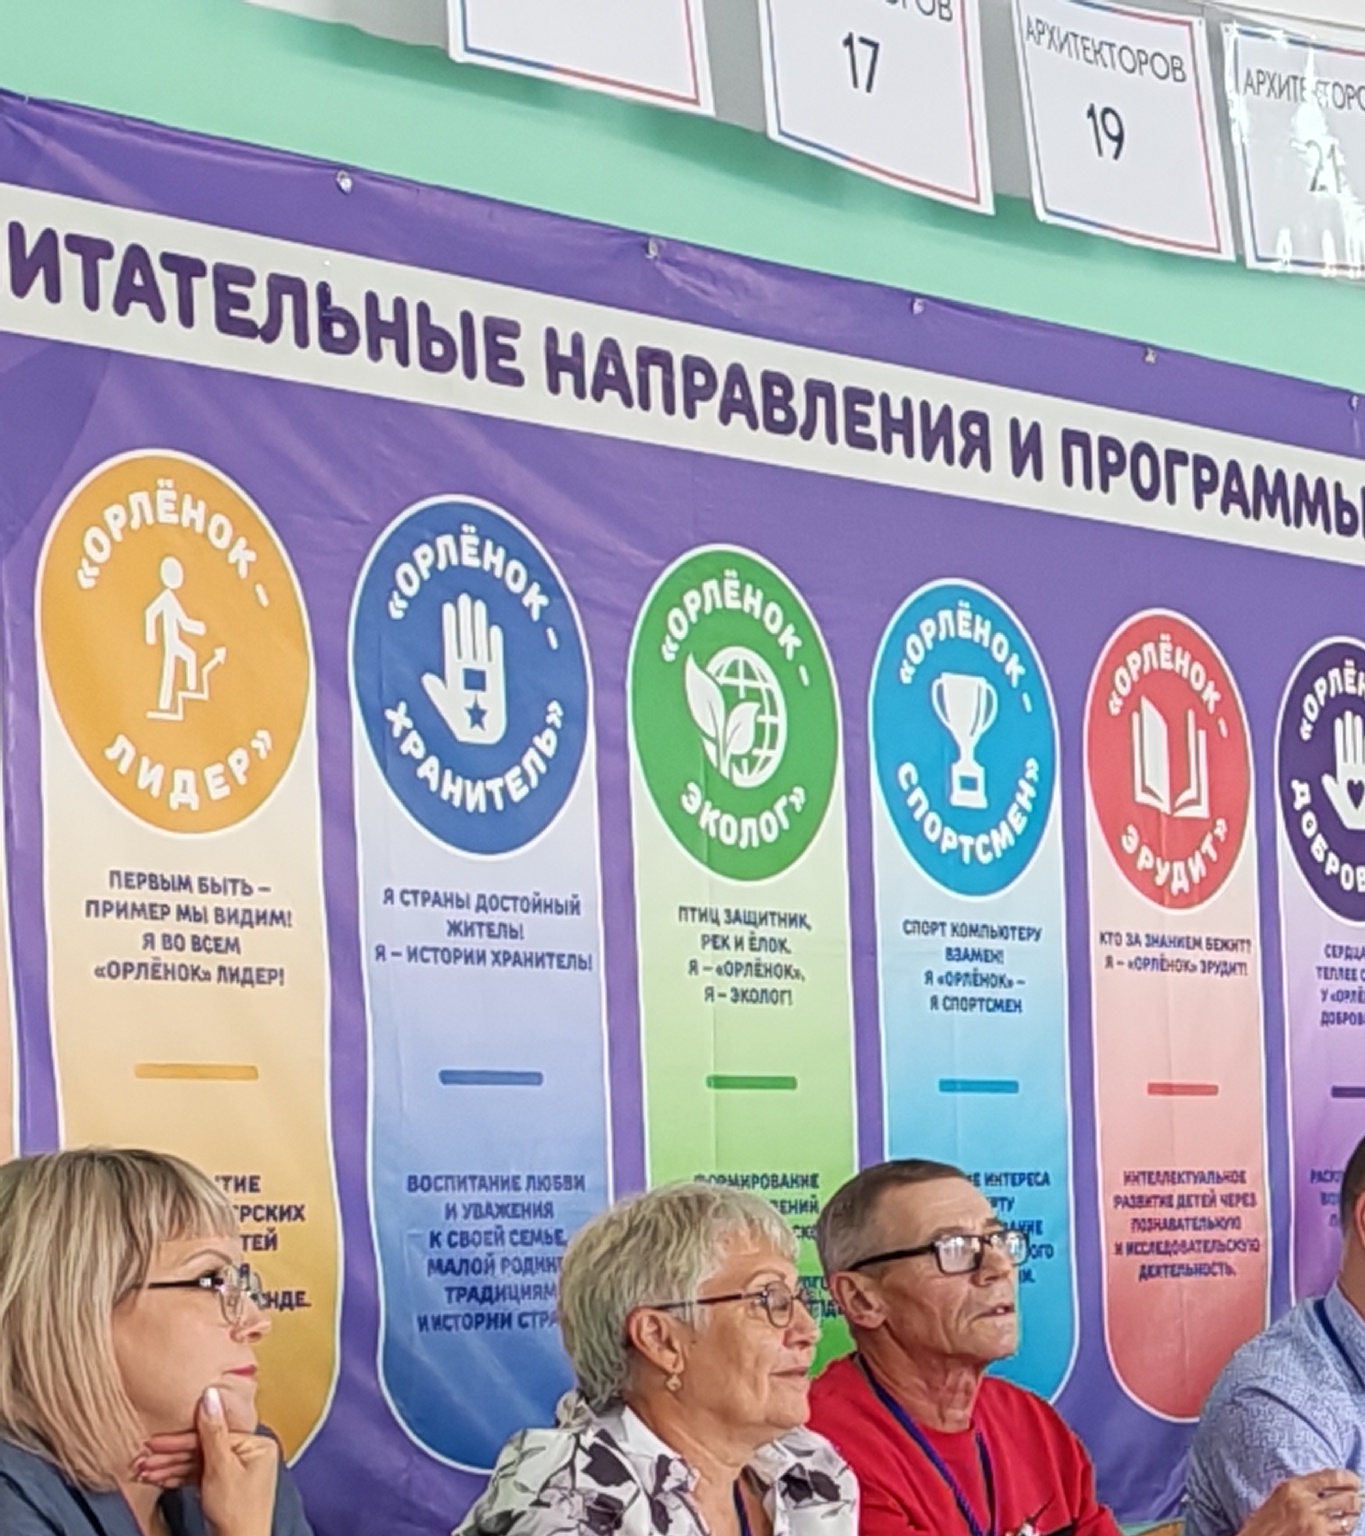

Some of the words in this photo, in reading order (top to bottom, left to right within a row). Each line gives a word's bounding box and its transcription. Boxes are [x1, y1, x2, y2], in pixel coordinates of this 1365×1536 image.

[1026, 15, 1188, 84] АРХИТЕКТОРОВ
[842, 32, 880, 93] 17
[1086, 103, 1126, 161] 19
[8, 221, 525, 389] ИТАТЕЛЬНЫЕ
[545, 326, 991, 474] НАПРАВЛЕНИЯ
[1010, 418, 1044, 483] И
[384, 700, 563, 813] ХРАНИТЕЛЬ»
[104, 729, 272, 811] ЛИДЕР»
[680, 781, 806, 849] ЭКОЛОГ»
[897, 757, 1040, 864] СПОРТСМЕН»
[109, 869, 193, 894] ПЕРВЫМ
[197, 876, 254, 896] БЫТЬ
[383, 887, 395, 906] Я
[399, 889, 471, 910] СТРАНЫ
[475, 891, 582, 916] ДОСТОЙНЫЙ
[85, 899, 171, 921] ПРИМЕР
[176, 904, 208, 924] МЫ
[213, 906, 293, 928] ВИДИМ!
[678, 905, 720, 926] ПТИЦ
[446, 919, 525, 941] ЖИТЕЛЬ!
[902, 919, 948, 937] СПОРТ
[950, 922, 1043, 942] КОМПЬЮТЕРУ
[1099, 931, 1123, 946] КТО
[1126, 933, 1142, 947] ЗА
[142, 932, 155, 951] Я
[161, 933, 186, 952] ВО
[190, 934, 241, 955] ВСЕМ
[701, 934, 731, 951] РЕК
[734, 935, 744, 951] И
[375, 944, 387, 962] Я
[406, 945, 487, 967] ИСТОРИИ
[491, 948, 593, 971] ХРАНИТЕЛЬ!
[944, 946, 1005, 964] ВЗАМЕН!
[1104, 955, 1114, 969] Я
[94, 956, 212, 983] «ОРЛЁНОК»
[216, 965, 285, 988] ЛИДЕР!
[688, 958, 699, 976] Я
[924, 970, 934, 986] Я
[704, 985, 715, 1003] Я
[730, 986, 794, 1006] ЭКОЛОГ!
[930, 995, 939, 1011] Я
[407, 1174, 522, 1193] ВОСПИТАНИЕ
[525, 1174, 586, 1193] ЛЮБВИ
[444, 1203, 457, 1220] И
[462, 1201, 554, 1220] УВАЖЕНИЯ
[429, 1231, 442, 1248] К
[447, 1224, 505, 1248] СВОЕЙ
[427, 1252, 496, 1277] МАЛОЙ
[417, 1313, 429, 1333] И
[431, 1312, 512, 1332] ИСТОРИИ
